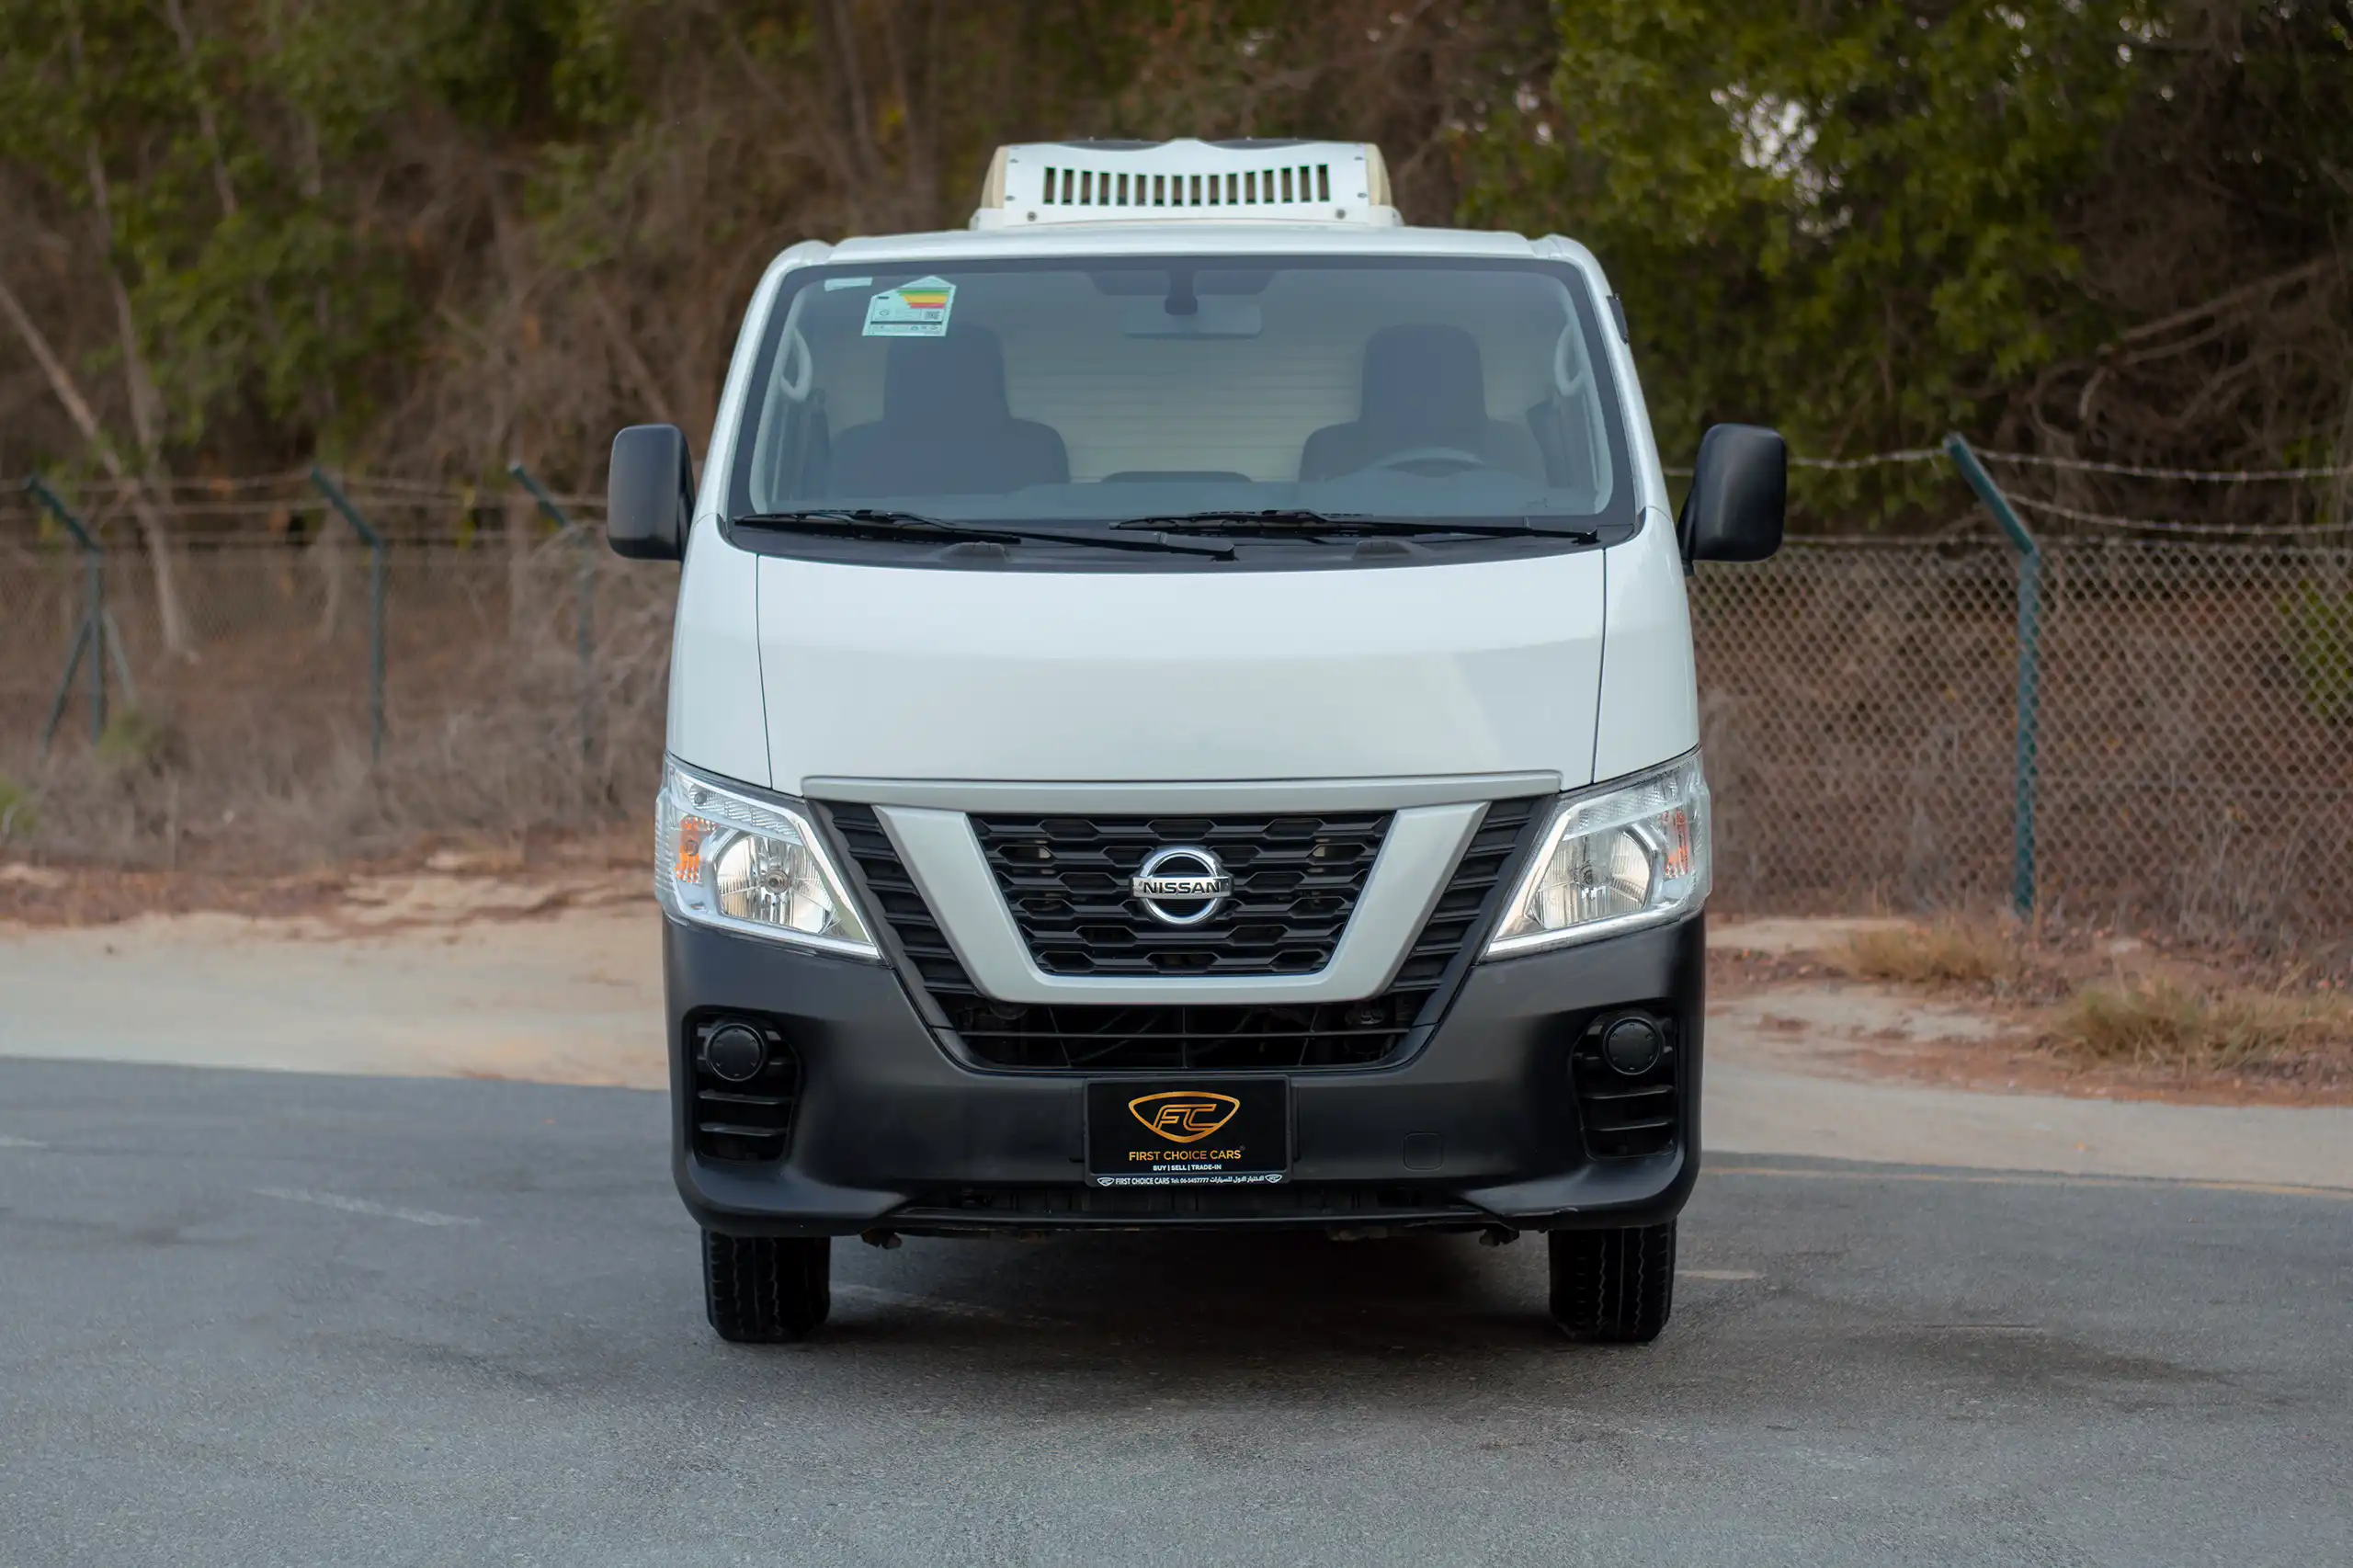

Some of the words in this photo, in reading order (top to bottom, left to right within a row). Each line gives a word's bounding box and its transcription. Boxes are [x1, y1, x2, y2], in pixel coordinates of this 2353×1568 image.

[1142, 881, 1221, 894] NISSAN
[1154, 1103, 1219, 1131] FC
[1129, 1151, 1161, 1161] FIRST
[1163, 1150, 1208, 1161] CHOICE
[1209, 1149, 1242, 1160] CARS
